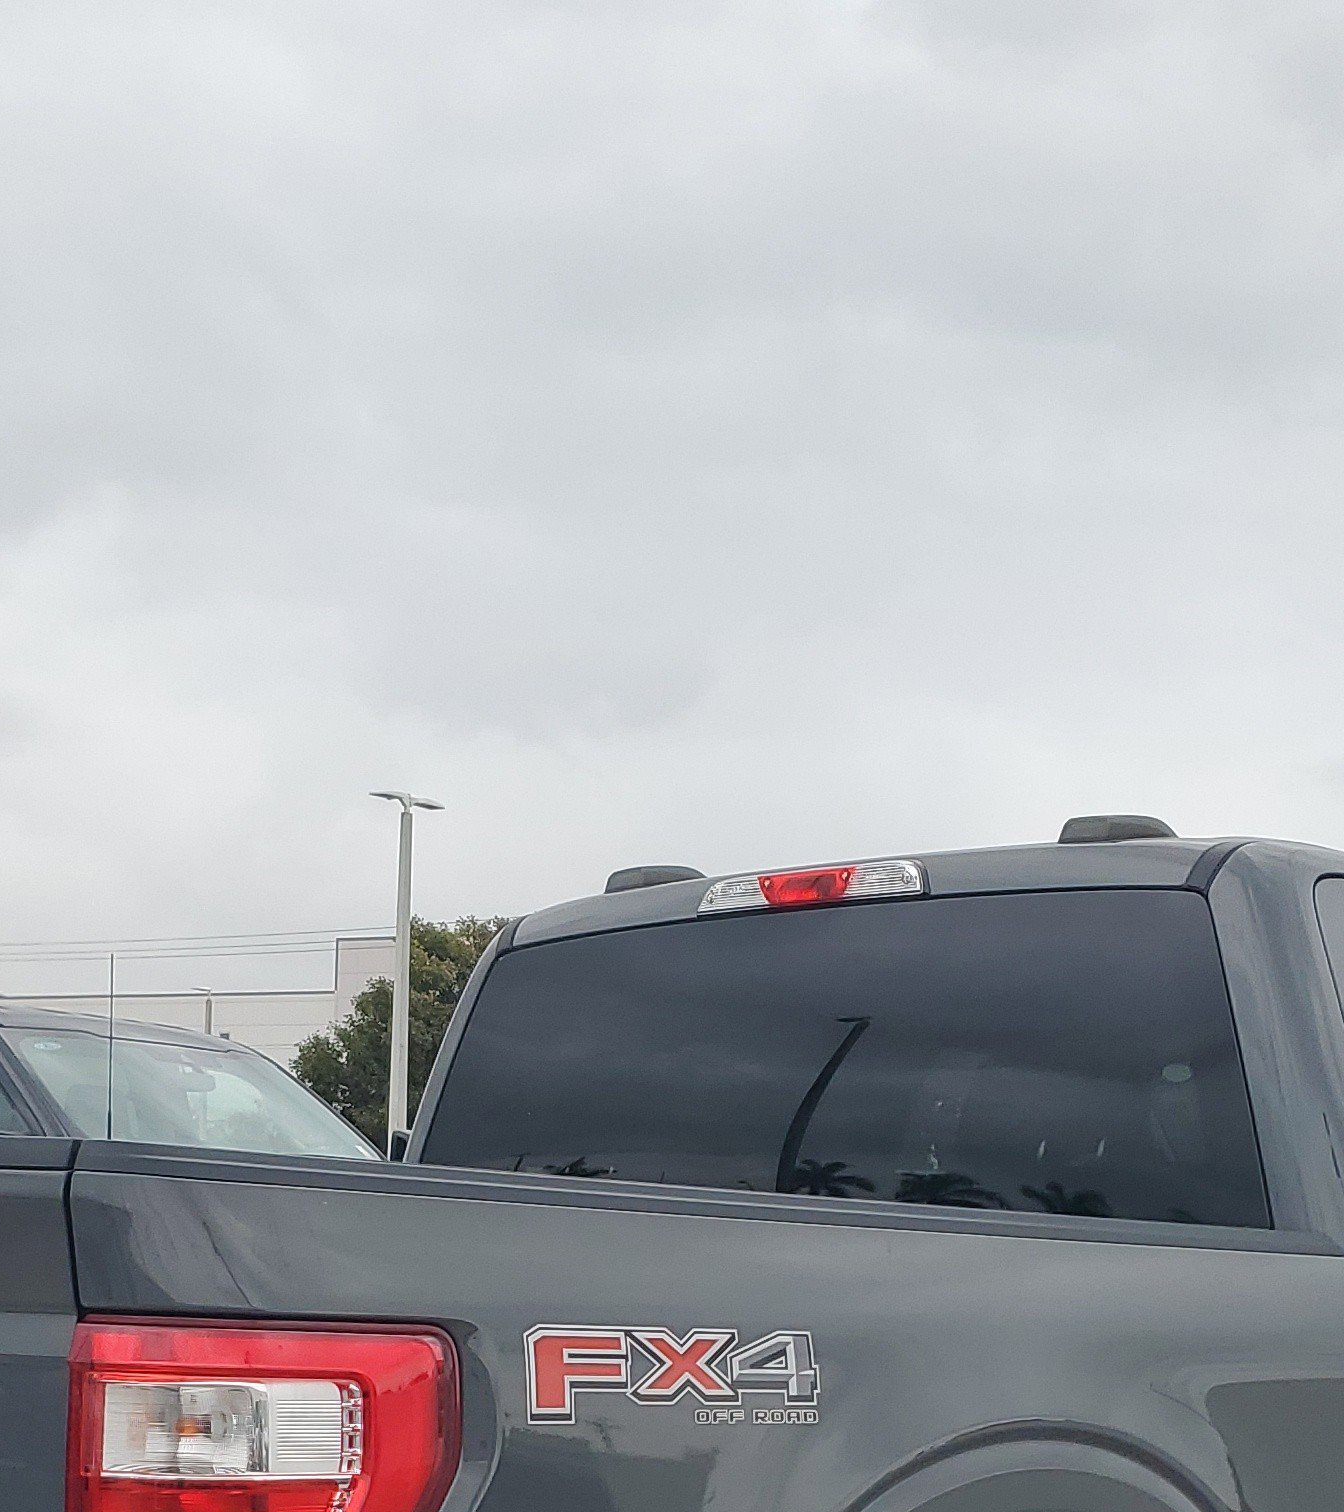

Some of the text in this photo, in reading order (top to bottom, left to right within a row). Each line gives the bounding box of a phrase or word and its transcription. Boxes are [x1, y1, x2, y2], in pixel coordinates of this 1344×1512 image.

[523, 1323, 821, 1425] FX4
[694, 1408, 819, 1425] OFF ROAD
